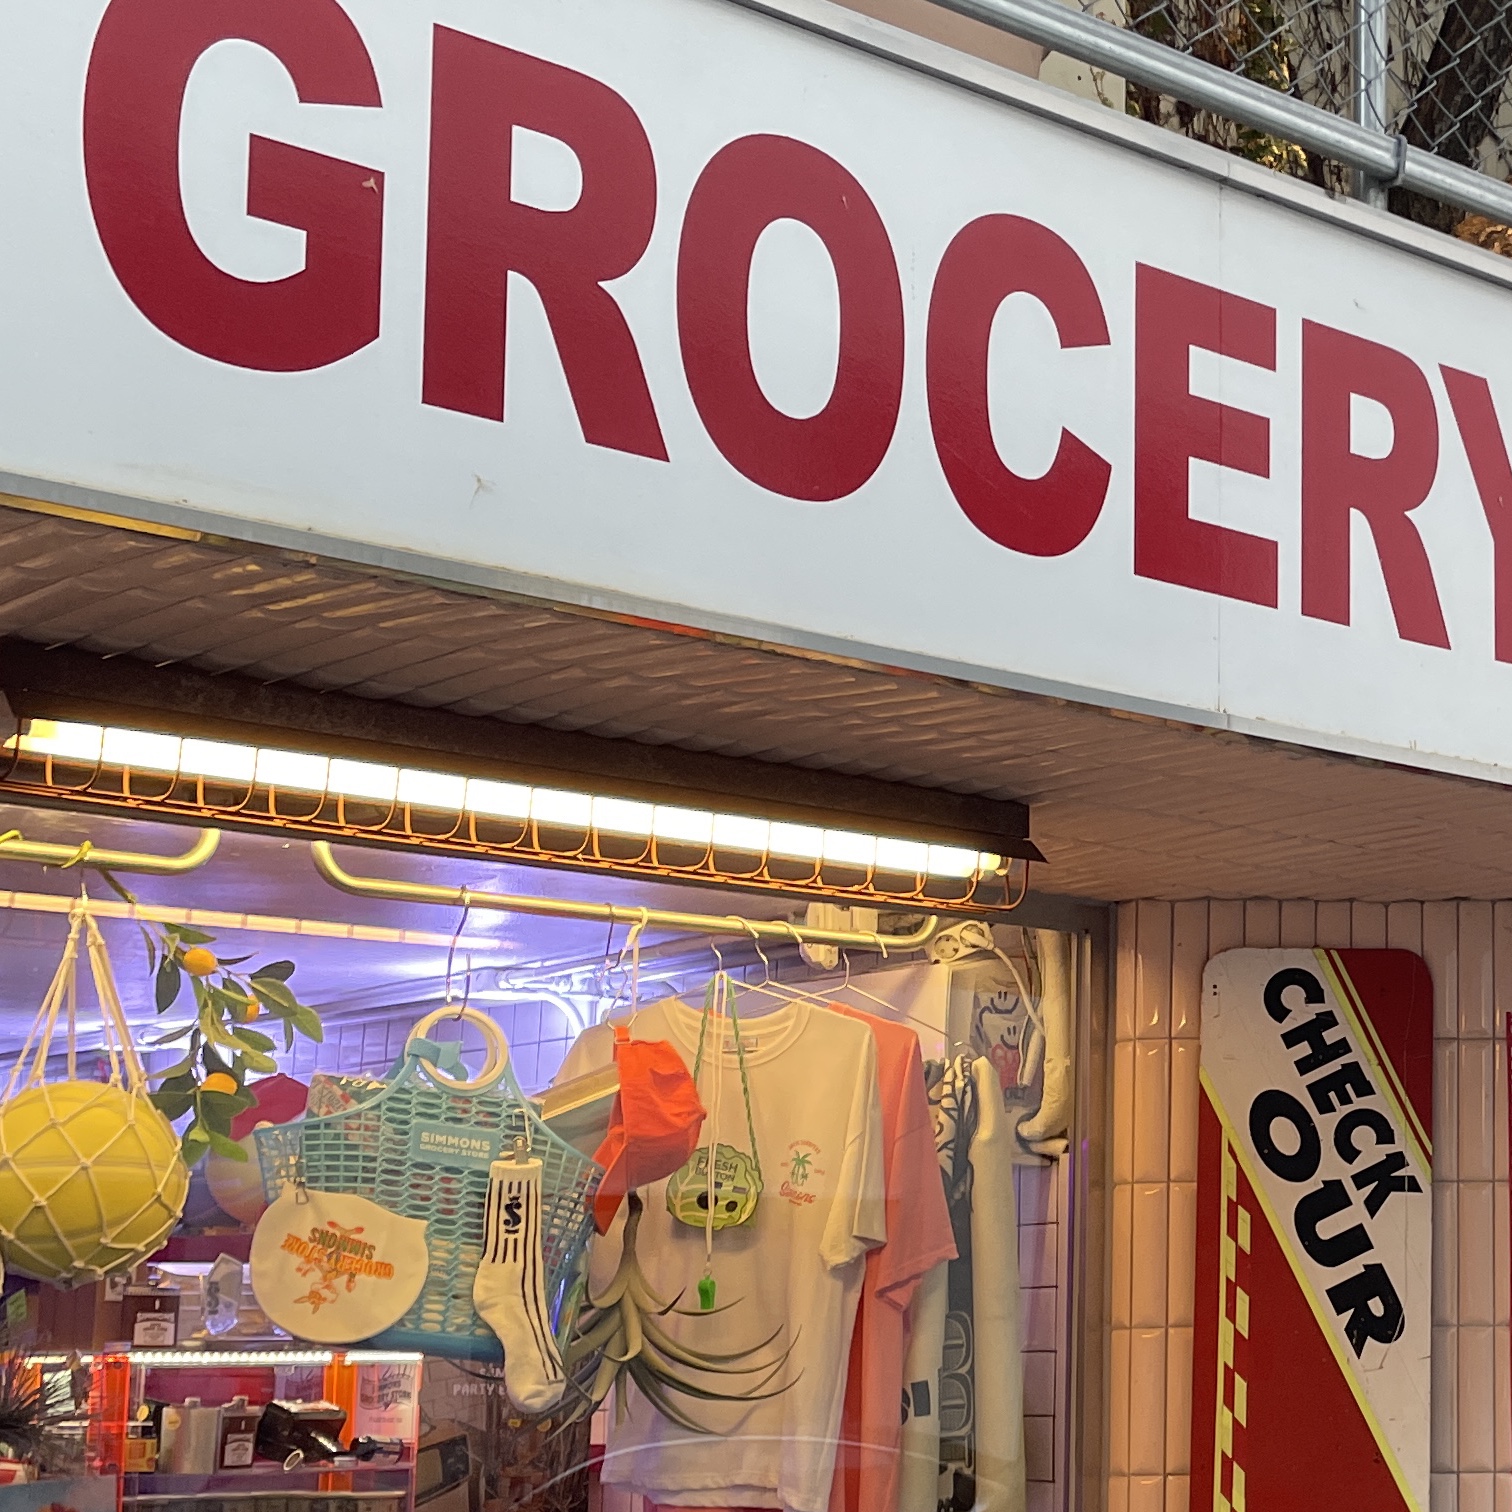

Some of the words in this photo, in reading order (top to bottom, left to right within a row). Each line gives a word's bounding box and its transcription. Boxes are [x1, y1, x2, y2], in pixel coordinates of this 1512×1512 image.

[1264, 968, 1424, 1220] CHECK
[419, 1143, 460, 1157] GROCERY
[461, 1148, 490, 1159] STORE
[420, 1131, 491, 1150] SIMMONS
[1249, 1089, 1405, 1359] OUR
[308, 1227, 376, 1260] SIMMONS
